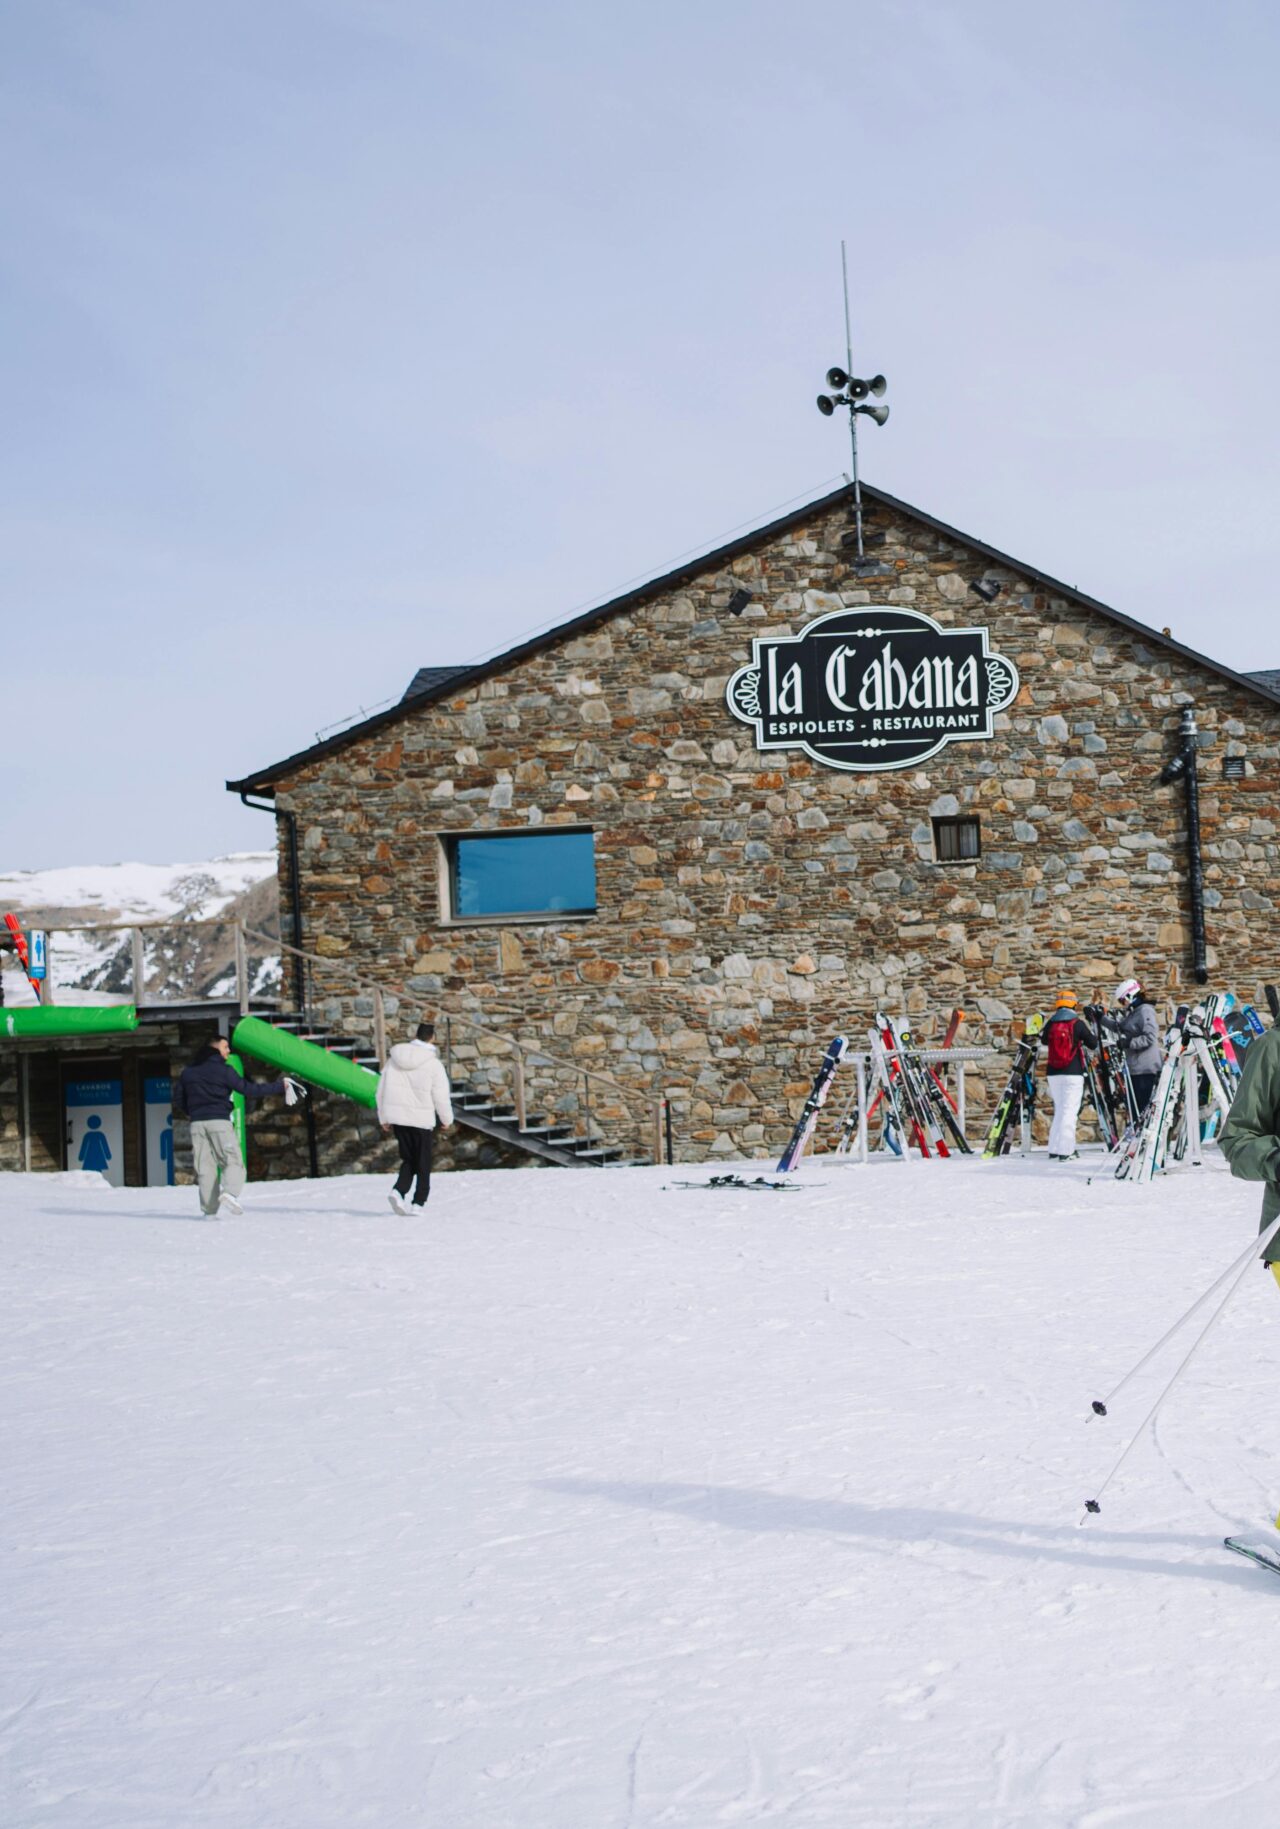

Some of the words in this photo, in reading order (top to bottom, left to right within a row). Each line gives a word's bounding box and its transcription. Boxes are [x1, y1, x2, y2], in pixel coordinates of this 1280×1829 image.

[767, 646, 804, 716] la
[825, 641, 980, 712] Cabana
[769, 718, 855, 736] ESPIOLETS
[872, 713, 980, 731] RESTAURANT
